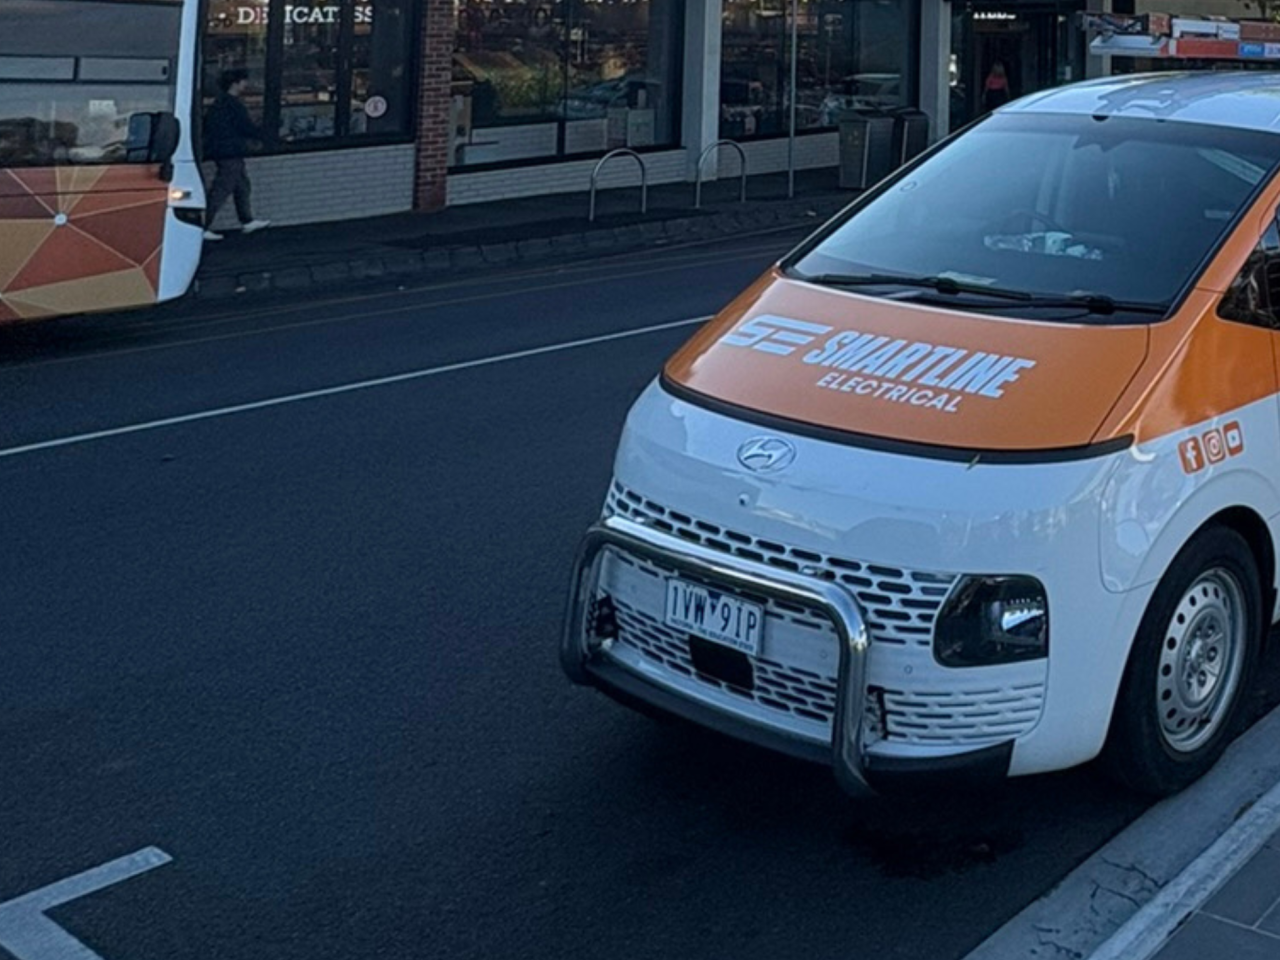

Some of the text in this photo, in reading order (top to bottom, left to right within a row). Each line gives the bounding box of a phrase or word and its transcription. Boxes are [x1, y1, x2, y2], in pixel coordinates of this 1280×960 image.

[802, 331, 1037, 399] SMARTLINE
[816, 371, 962, 413] ELECTRICAL
[672, 585, 707, 626] 1VW
